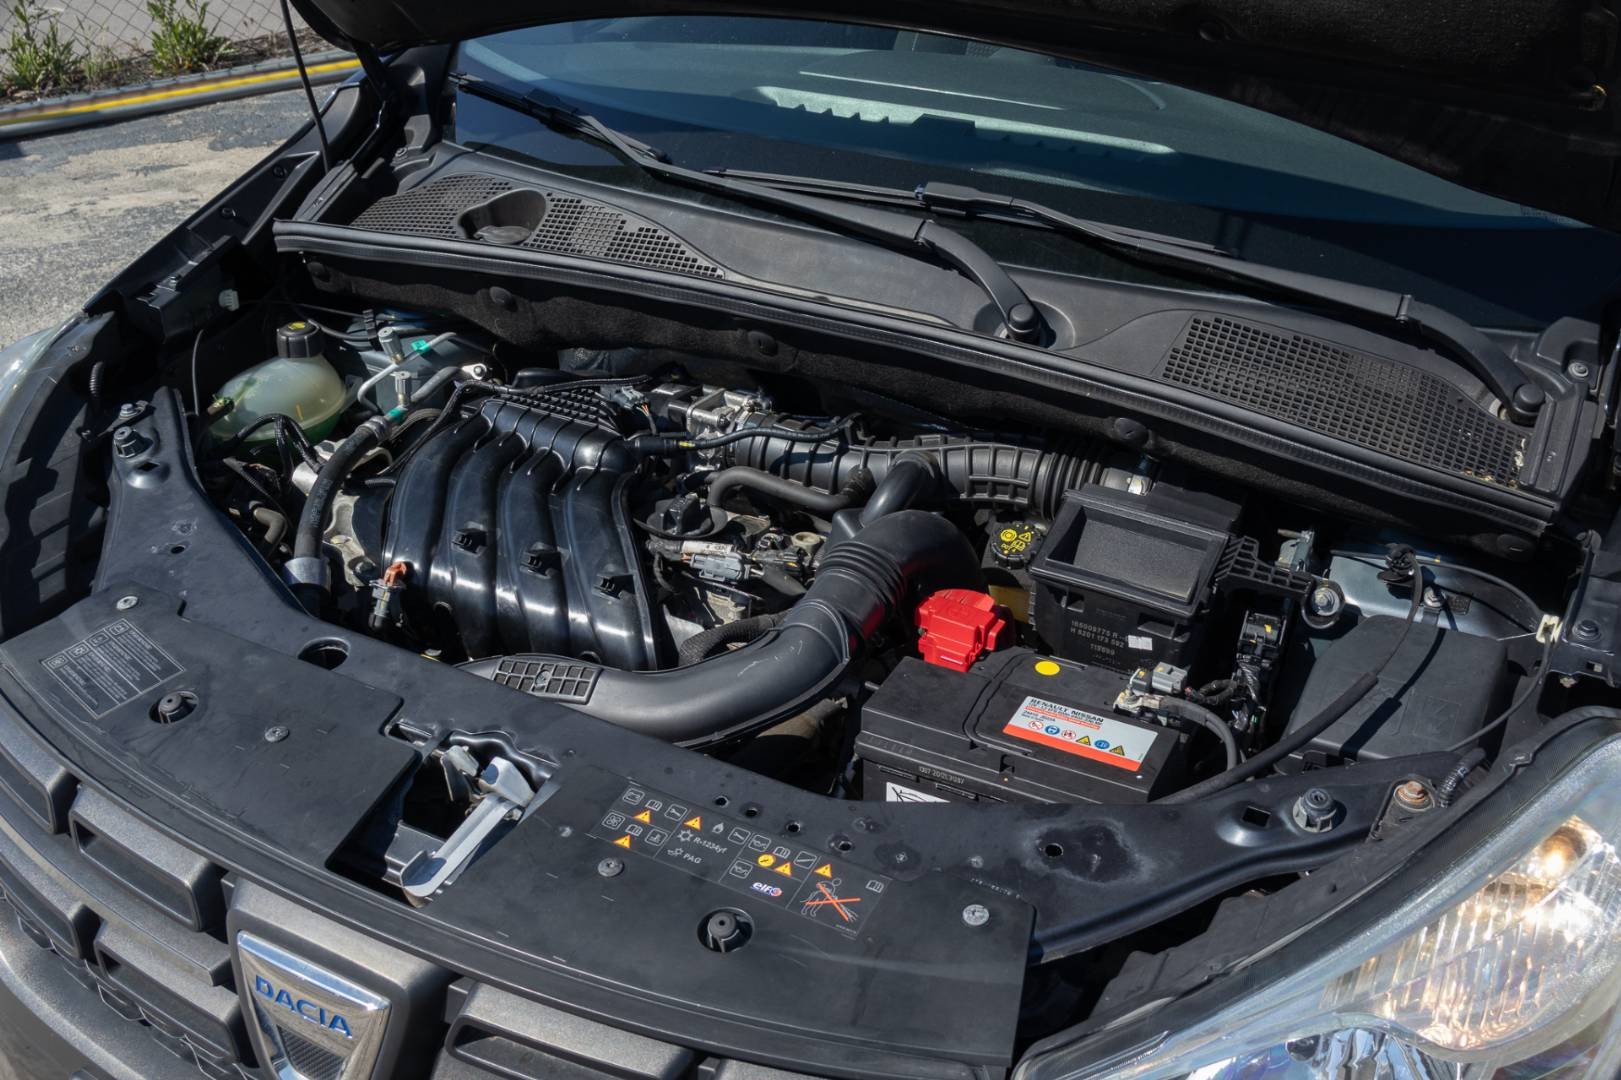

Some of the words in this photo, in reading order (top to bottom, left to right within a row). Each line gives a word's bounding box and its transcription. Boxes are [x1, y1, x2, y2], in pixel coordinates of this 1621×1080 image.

[1030, 698, 1068, 713] RENAULT
[1070, 710, 1104, 723] NISSAN
[693, 837, 728, 854] R-1234yf
[683, 853, 702, 864] PAG
[255, 974, 353, 1039] DACIA
